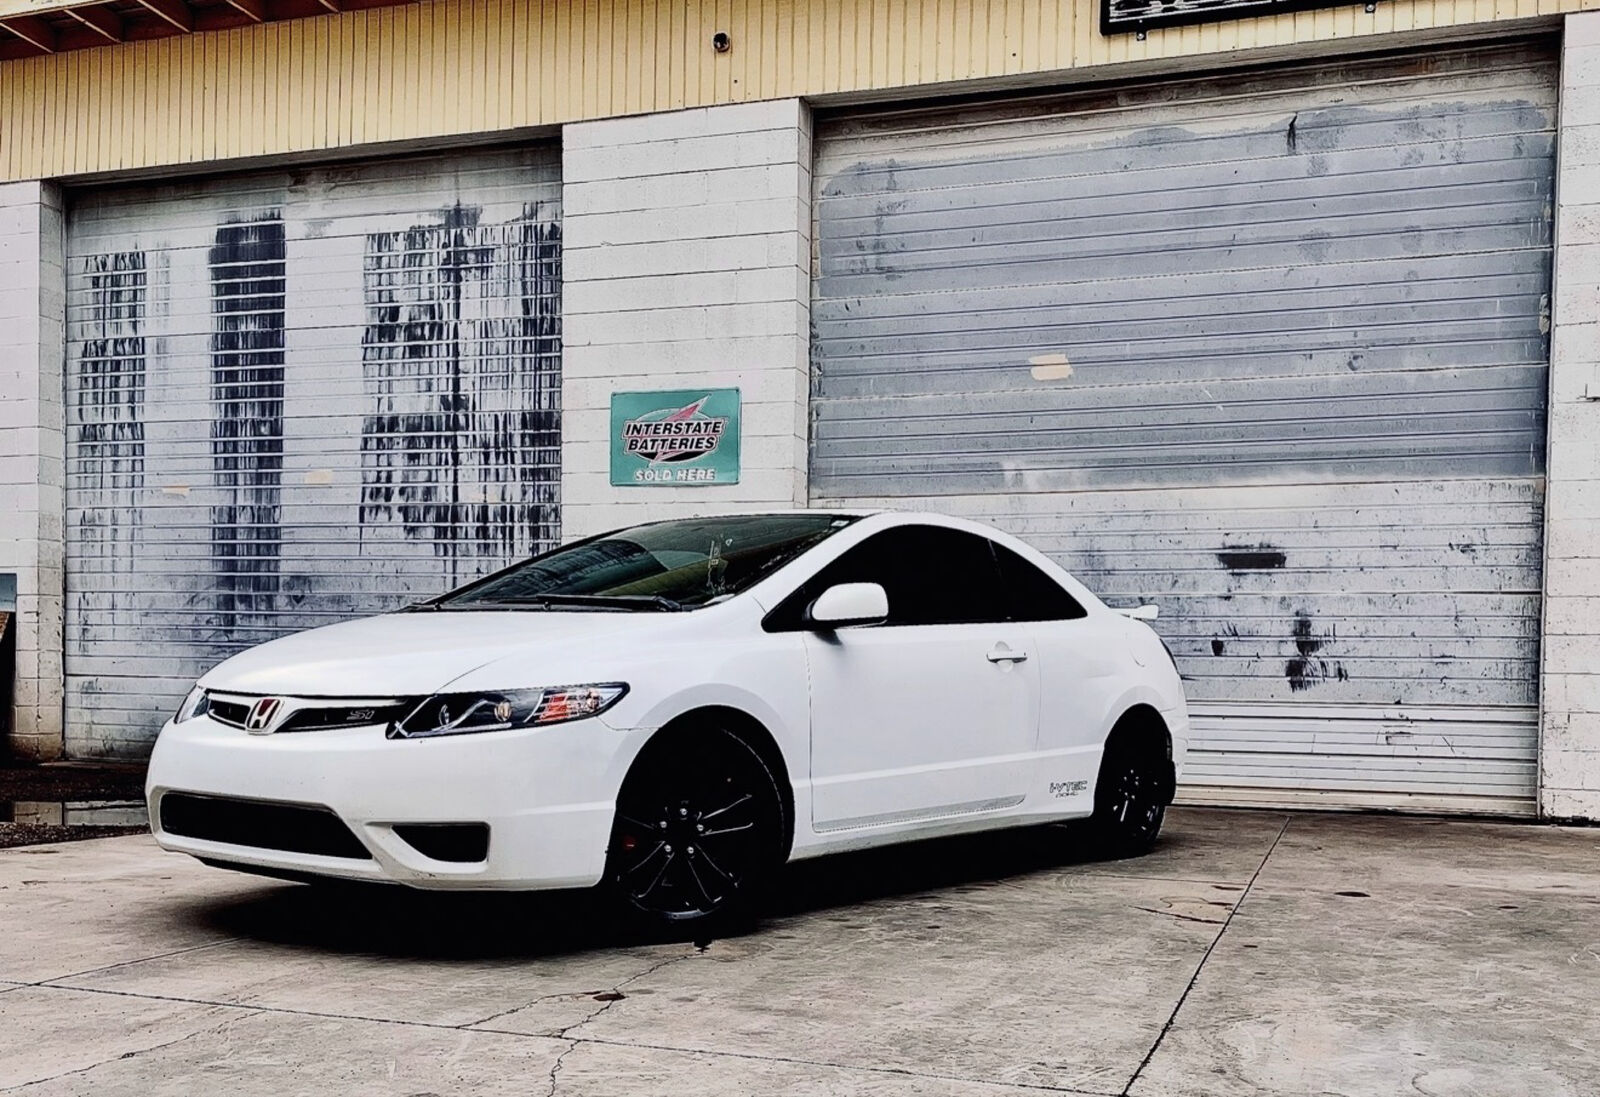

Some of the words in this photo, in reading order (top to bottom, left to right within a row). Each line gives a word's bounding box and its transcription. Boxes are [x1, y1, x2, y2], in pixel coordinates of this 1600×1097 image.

[625, 421, 722, 436] INTERSTATE
[628, 436, 715, 451] BATTERIES
[635, 469, 672, 481] SOLD
[676, 468, 716, 481] HERE
